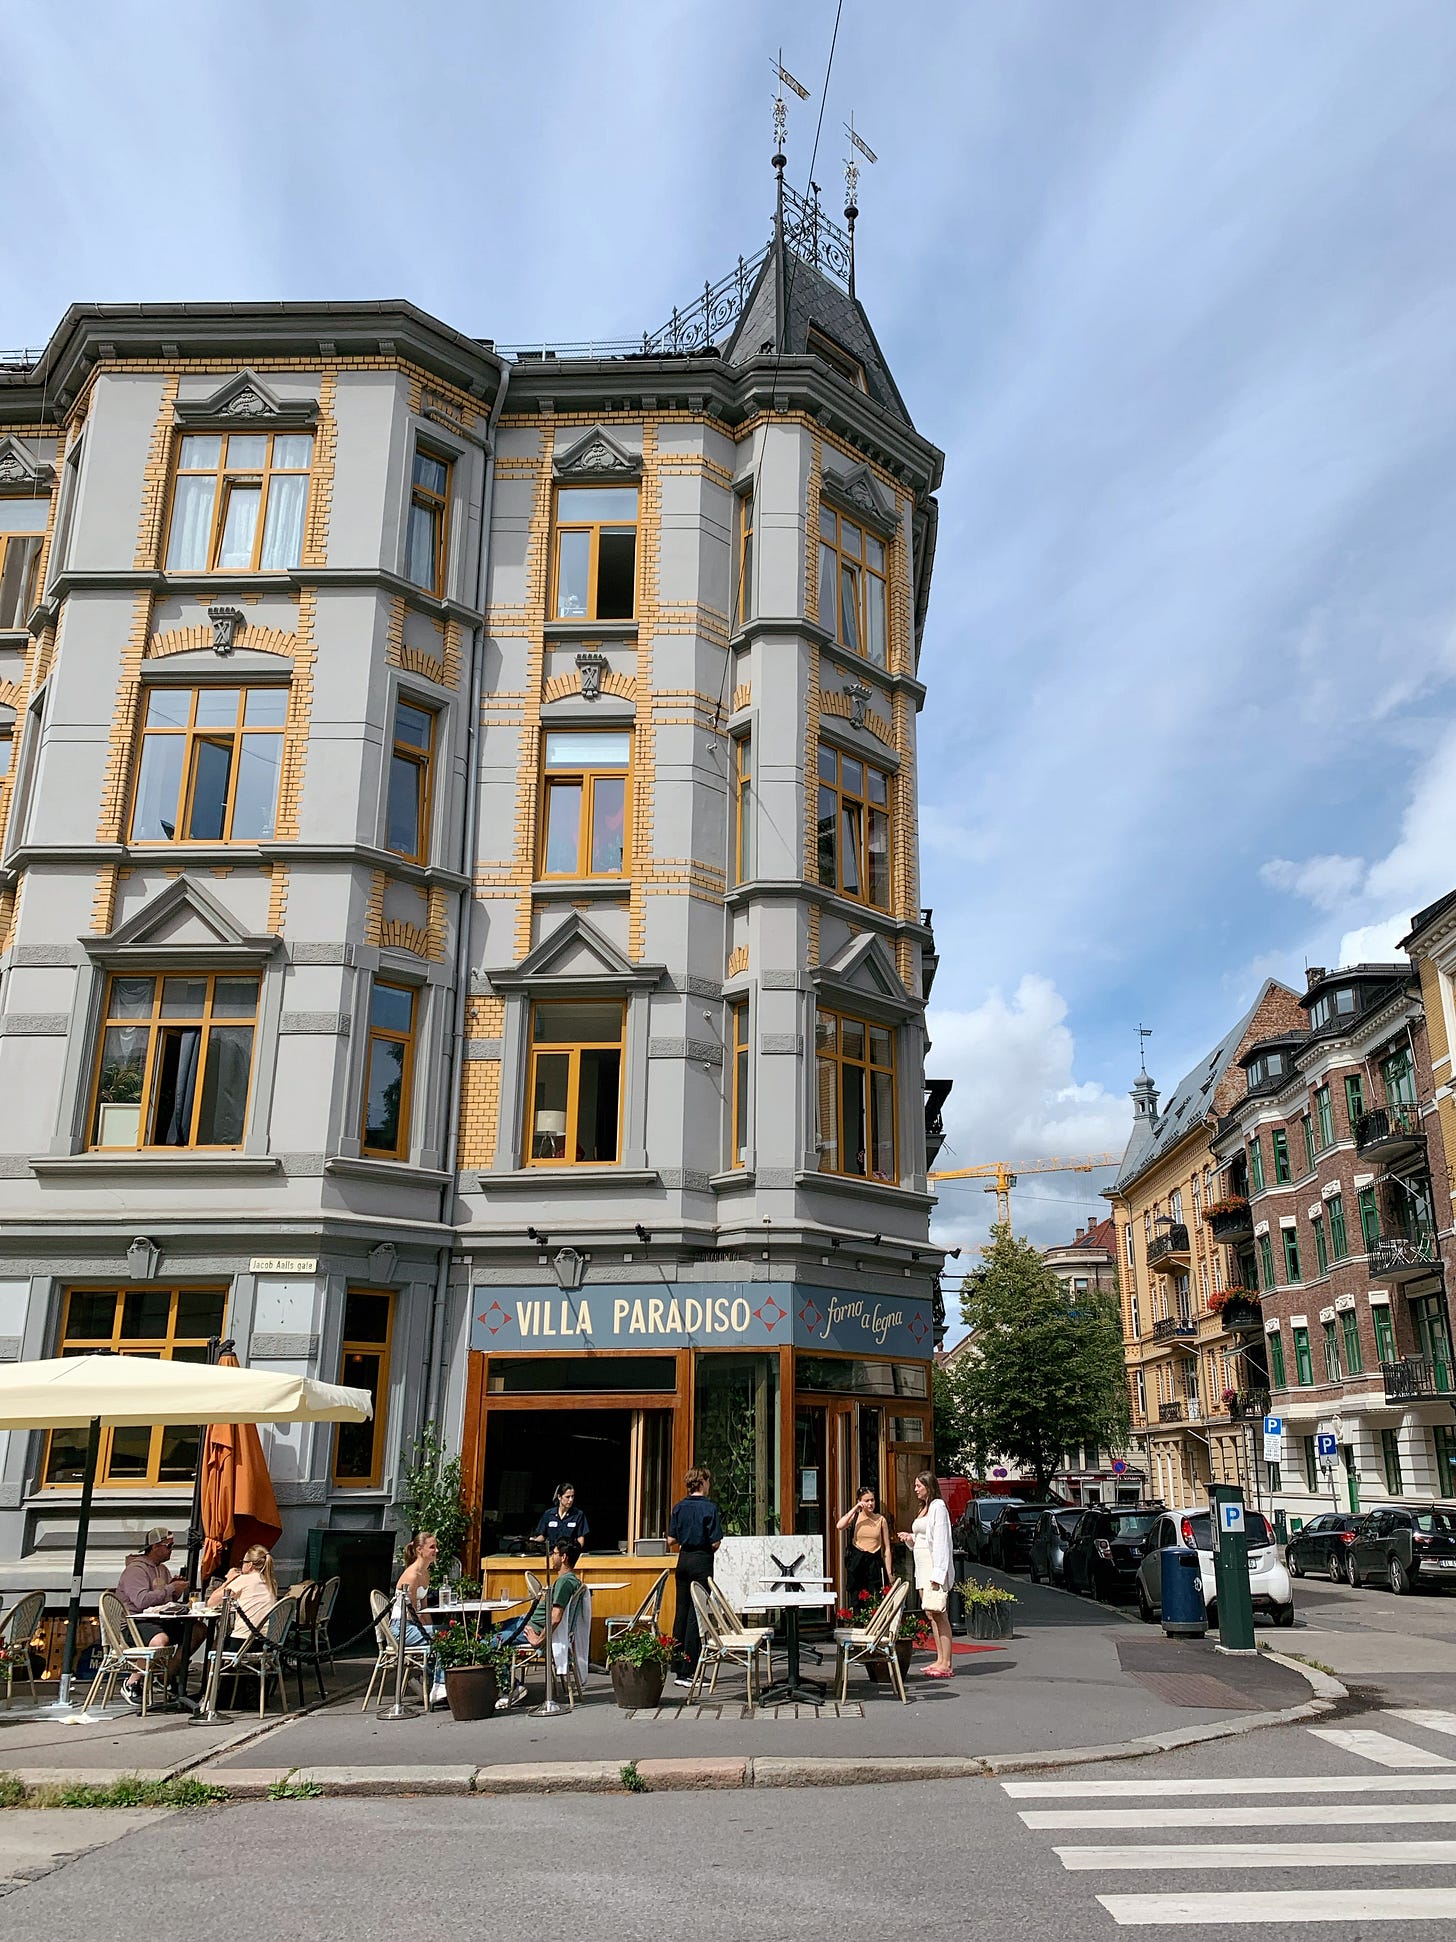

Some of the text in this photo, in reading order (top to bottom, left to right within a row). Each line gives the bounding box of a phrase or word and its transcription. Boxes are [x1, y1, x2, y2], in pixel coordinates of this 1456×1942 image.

[252, 1260, 273, 1270] Jacob
[296, 1262, 313, 1272] gate
[515, 1297, 752, 1337] VILLA PARADISO
[819, 1296, 903, 1345] forno a legna
[1268, 1419, 1277, 1432] P
[1322, 1437, 1332, 1453] P
[1226, 1507, 1240, 1527] P
